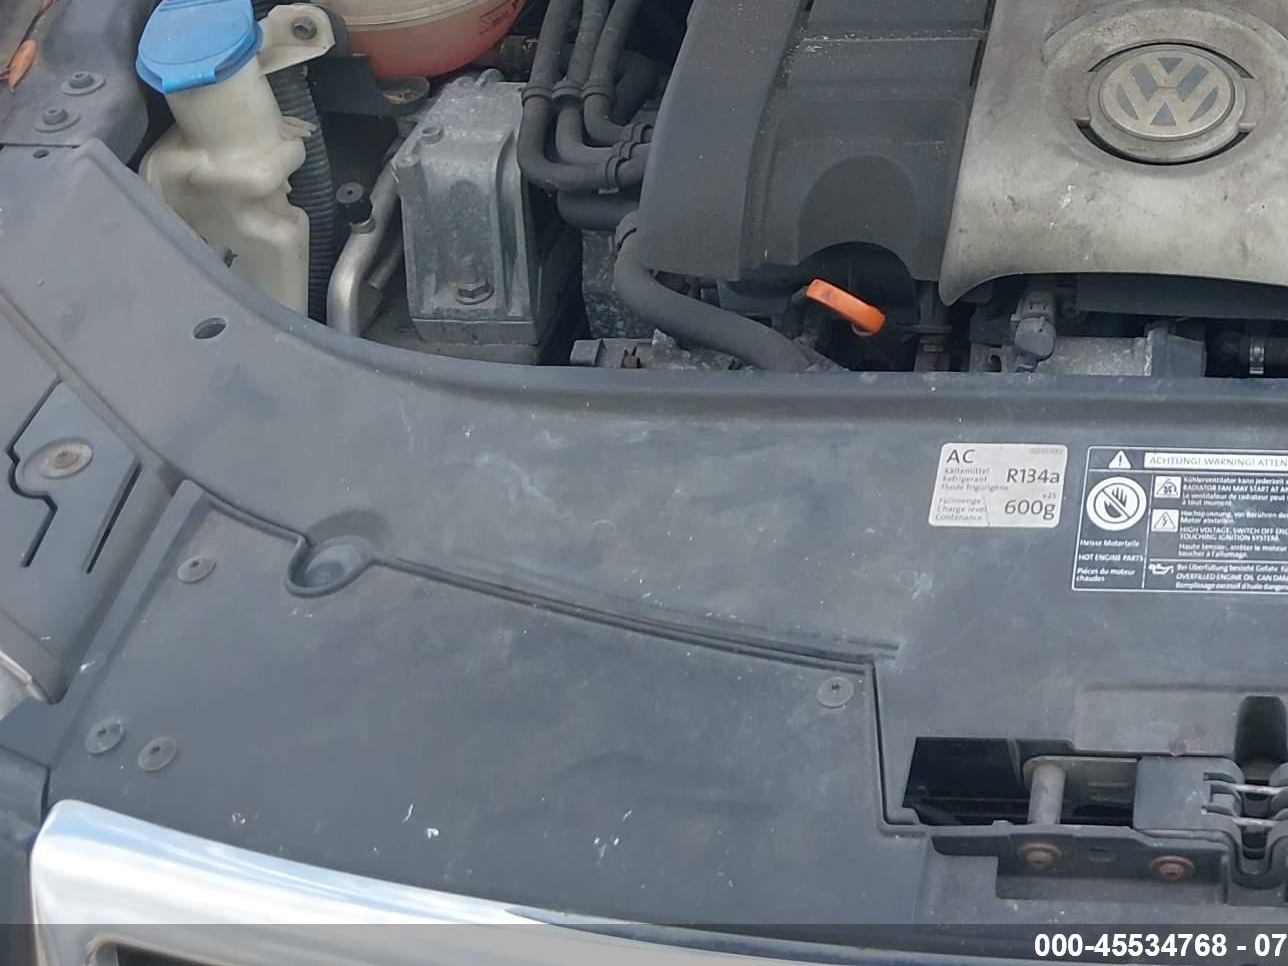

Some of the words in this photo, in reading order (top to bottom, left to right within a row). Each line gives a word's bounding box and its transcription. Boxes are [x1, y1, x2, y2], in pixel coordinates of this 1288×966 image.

[946, 449, 976, 464] AC
[1204, 456, 1255, 467] WARNING!
[1006, 468, 1060, 483] R134a
[1183, 476, 1237, 484] Kühlerventilator
[1255, 477, 1284, 486] jederzeit
[1218, 484, 1232, 492] FAN
[1249, 485, 1269, 493] START
[1270, 485, 1279, 493] AT
[1238, 493, 1269, 501] radiateur
[1269, 495, 1285, 503] peut
[937, 506, 965, 514] Charge
[1004, 499, 1056, 521] 600g
[935, 513, 983, 521] Contenance
[1260, 527, 1274, 535] OFF
[1103, 539, 1140, 547] Motorteile
[1078, 553, 1095, 561] HOT
[1095, 553, 1121, 561] ENGINE
[1122, 554, 1144, 562] PARTS
[1099, 567, 1109, 575] du
[1110, 568, 1136, 576] moteur
[1177, 563, 1188, 571] Bei
[1229, 564, 1254, 572] besteht
[1076, 574, 1105, 582] chaudes
[1176, 572, 1216, 580] OVERFILLED
[1216, 573, 1242, 581] ENGINE
[1257, 574, 1272, 582] CAN
[1175, 581, 1216, 591] Remplissage
